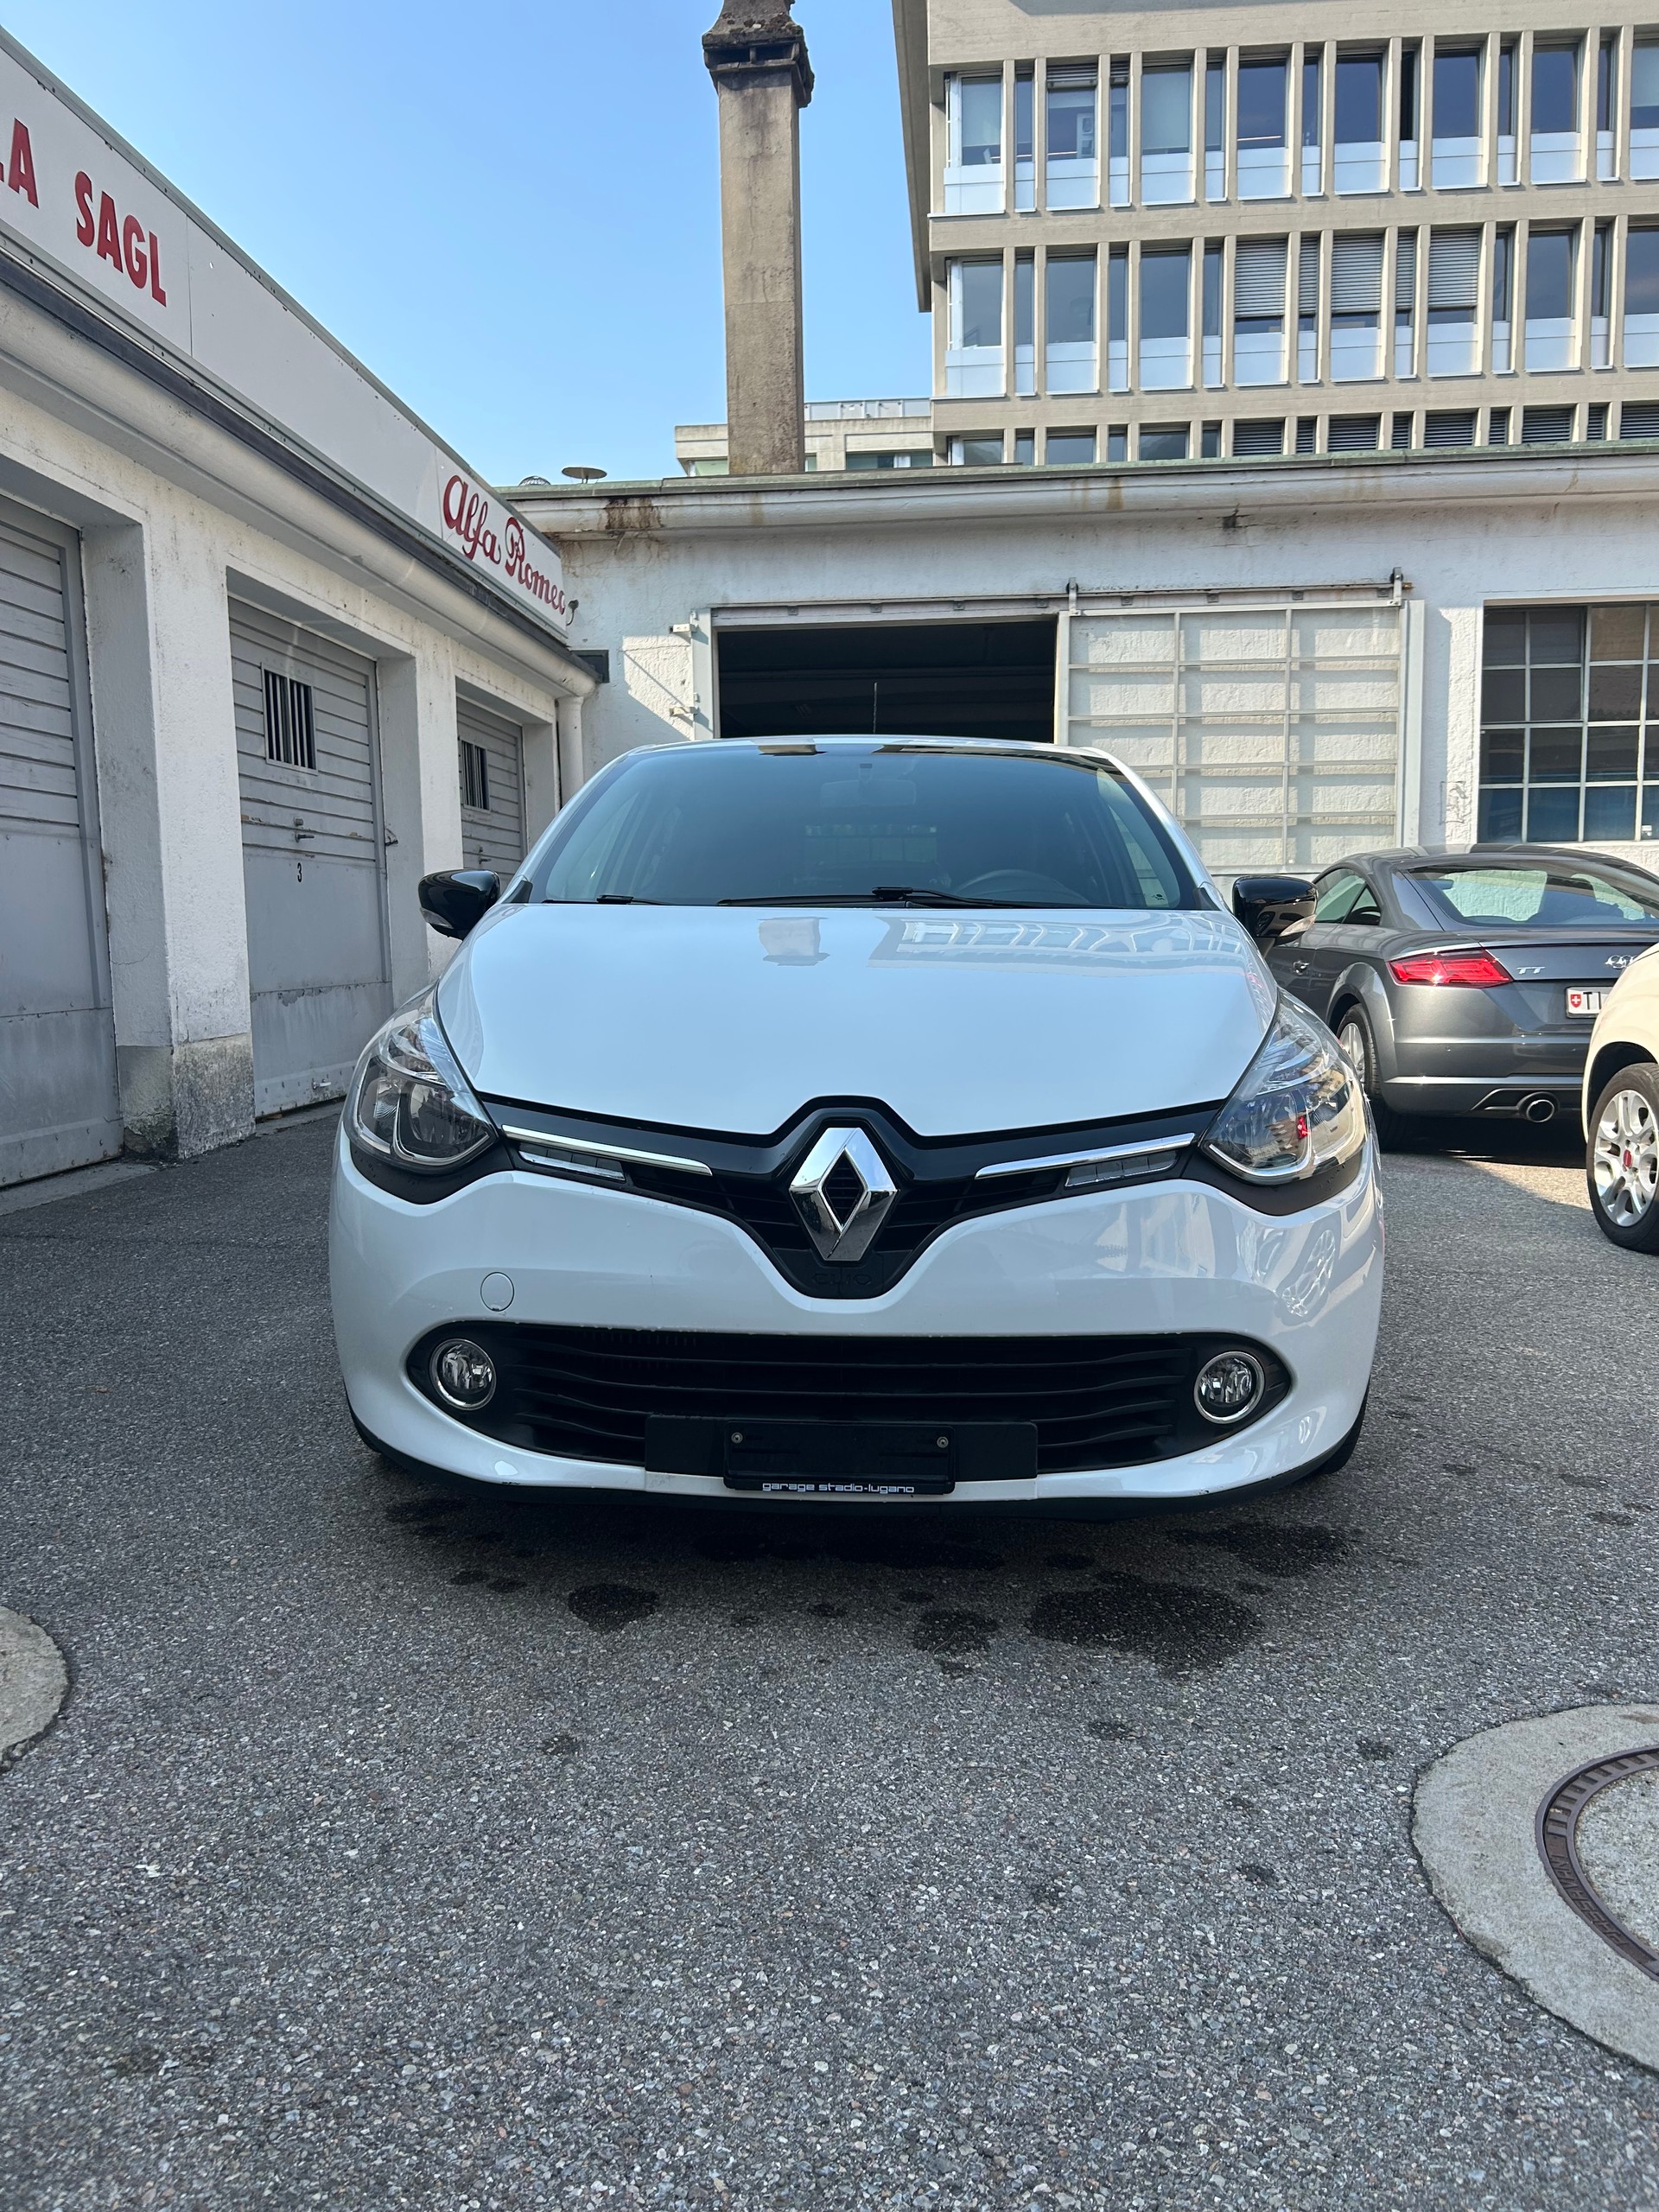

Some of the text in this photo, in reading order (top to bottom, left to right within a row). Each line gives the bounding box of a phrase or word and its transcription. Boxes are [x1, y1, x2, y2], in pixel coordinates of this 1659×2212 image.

[74, 170, 167, 308] SAGL
[443, 475, 501, 564] Alfa
[296, 862, 302, 882] 3
[1516, 966, 1546, 975] TT
[762, 1483, 815, 1492] garage
